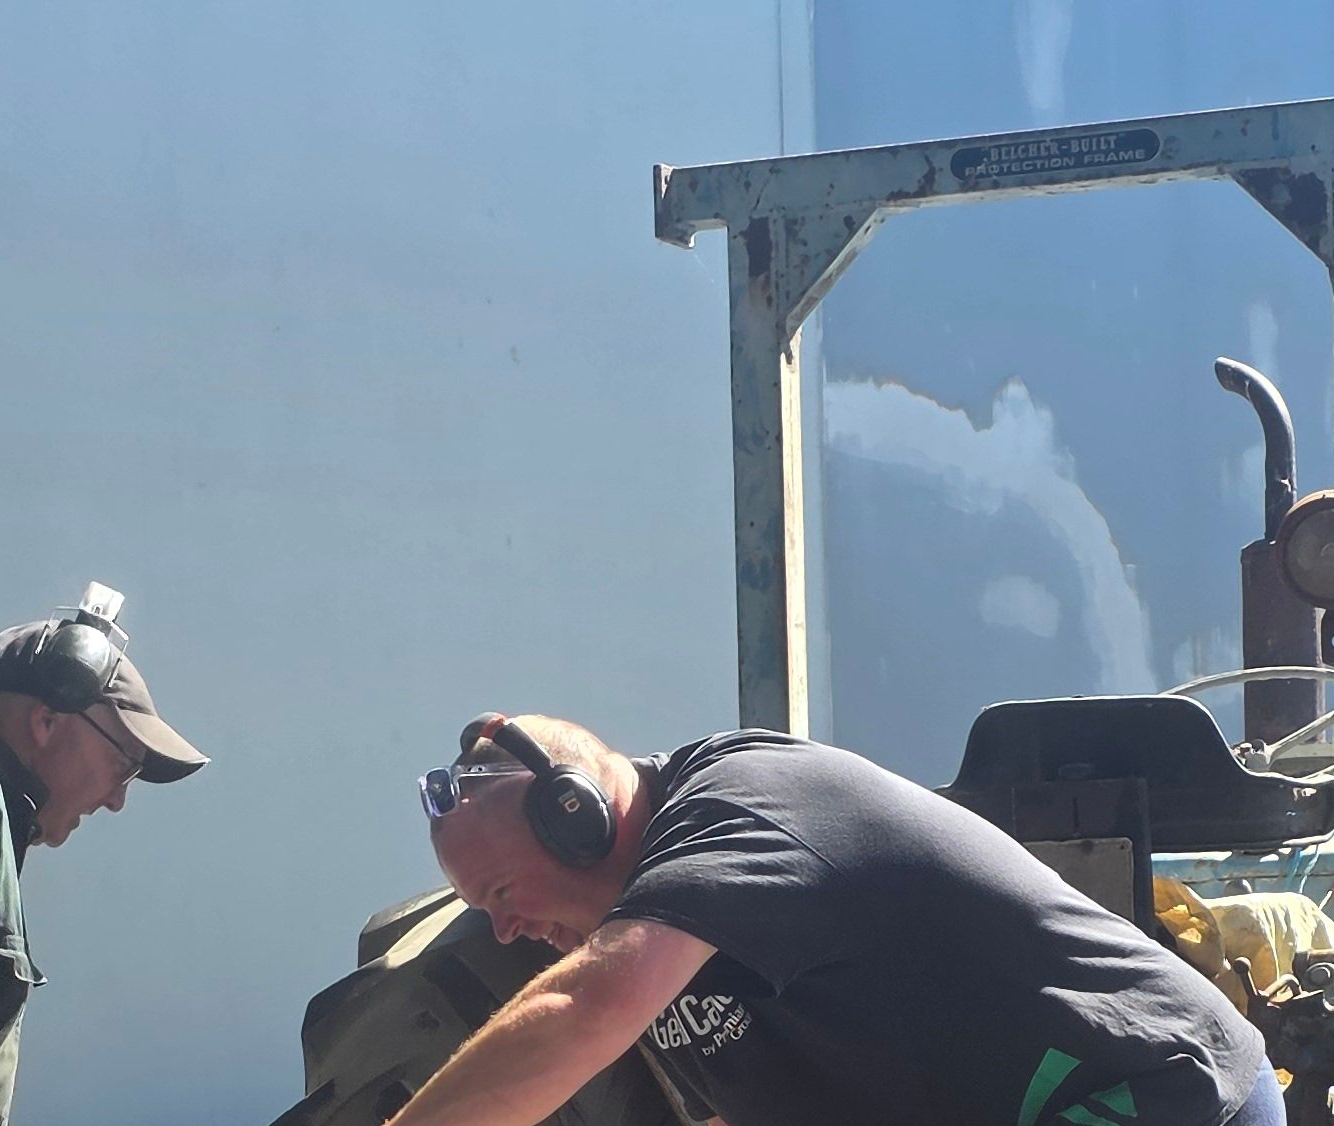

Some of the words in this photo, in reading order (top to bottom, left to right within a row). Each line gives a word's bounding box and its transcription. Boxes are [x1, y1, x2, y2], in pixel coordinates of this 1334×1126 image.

[965, 156, 1075, 177] PROTECTION
[1083, 149, 1146, 165] FRAME
[701, 1043, 716, 1056] by
